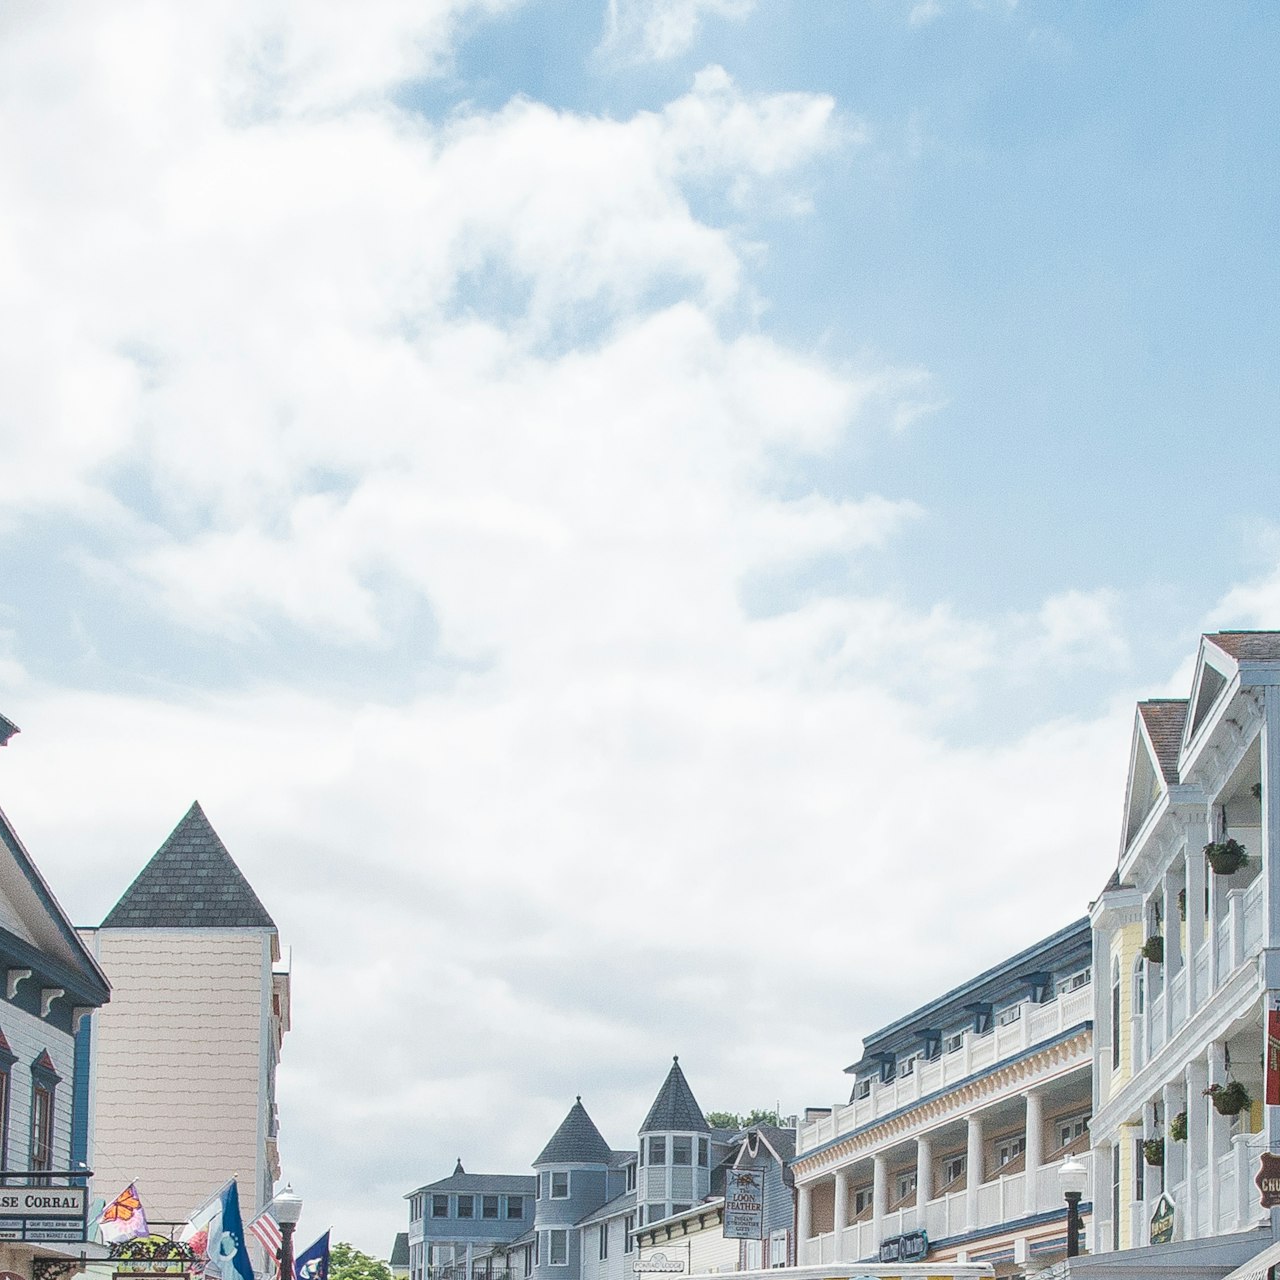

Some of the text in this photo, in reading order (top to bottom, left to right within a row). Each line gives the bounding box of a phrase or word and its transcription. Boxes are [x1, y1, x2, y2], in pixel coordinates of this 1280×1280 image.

[24, 1195, 80, 1209] CORRAL
[733, 1193, 756, 1202] LOON
[726, 1202, 762, 1211] FEATHER
